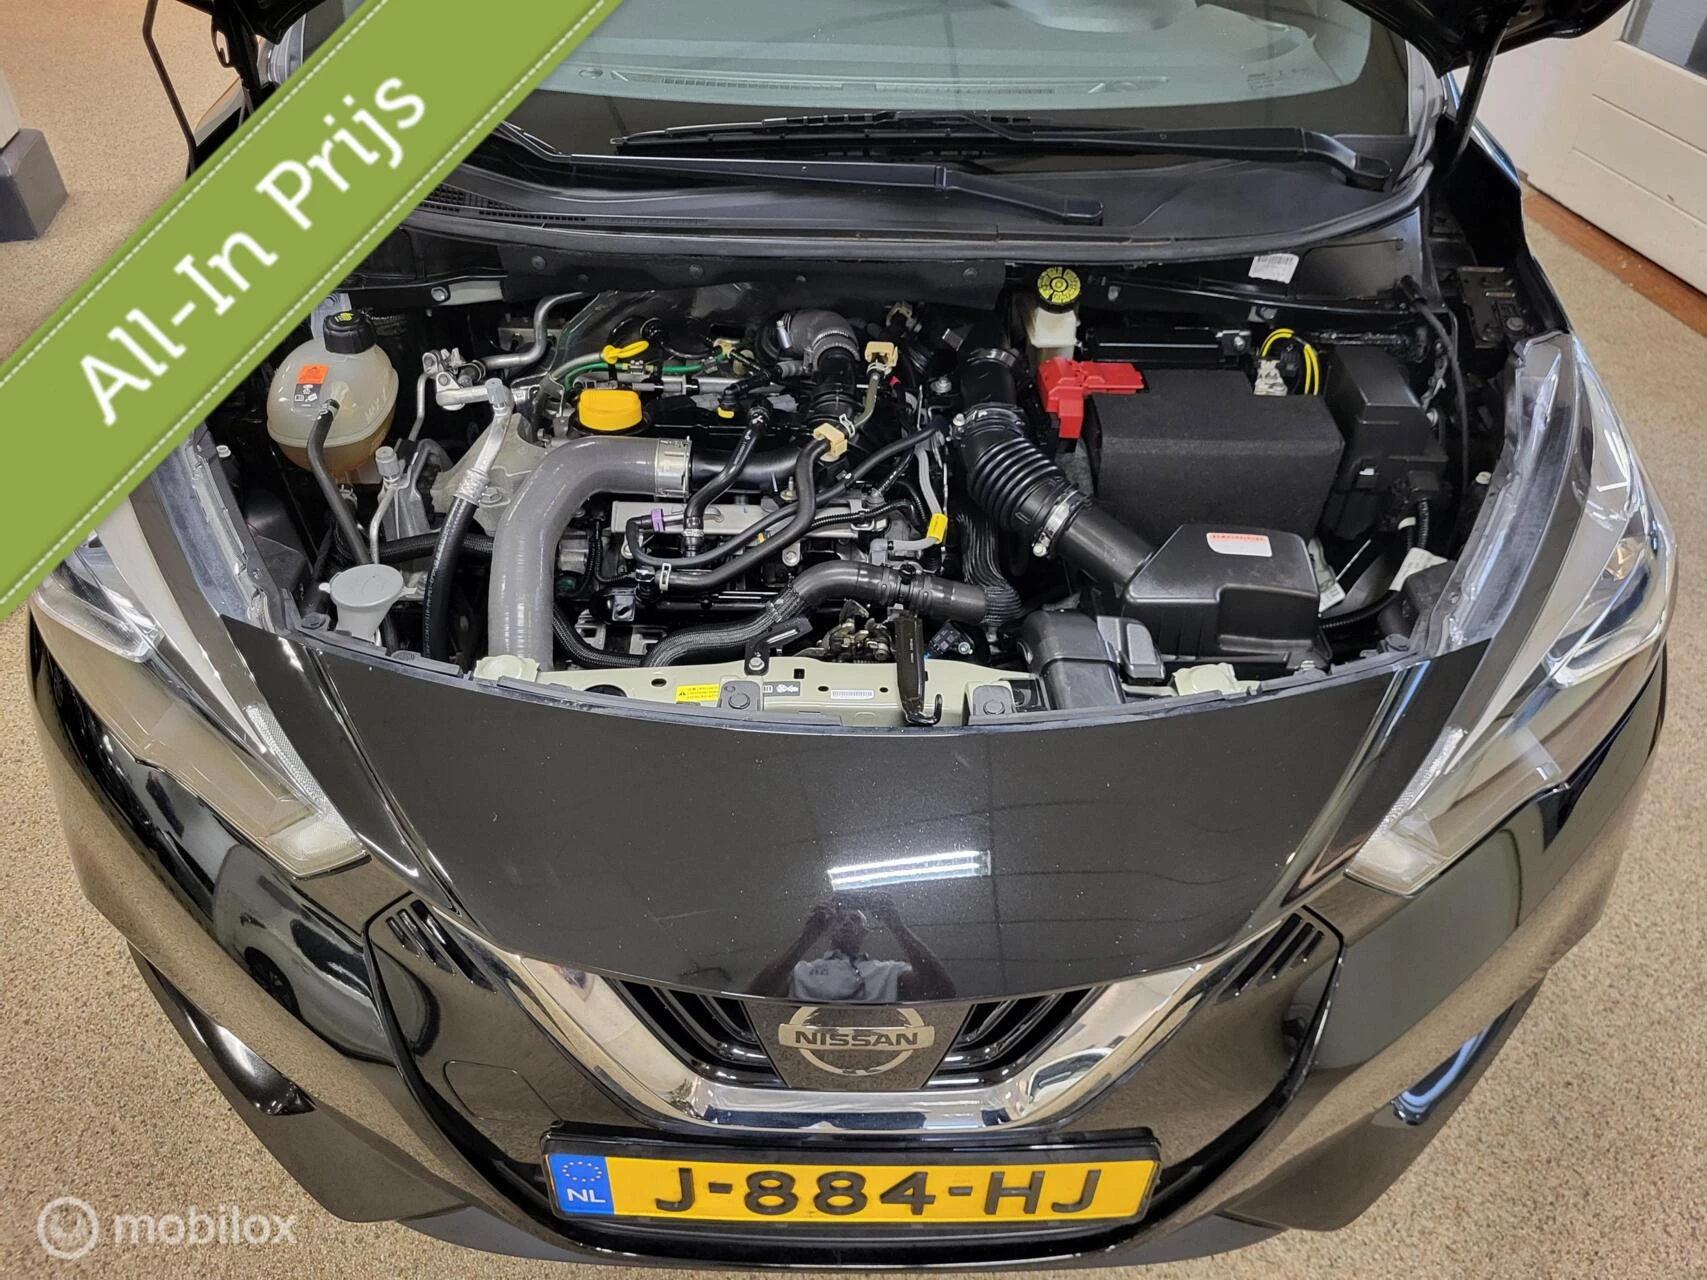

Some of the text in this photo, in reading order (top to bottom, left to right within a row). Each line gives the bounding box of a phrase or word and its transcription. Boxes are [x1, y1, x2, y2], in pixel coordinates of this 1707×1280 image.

[795, 1031, 918, 1047] NISSAN
[567, 1188, 606, 1203] NL
[655, 1167, 1101, 1215] J-884-HJ
